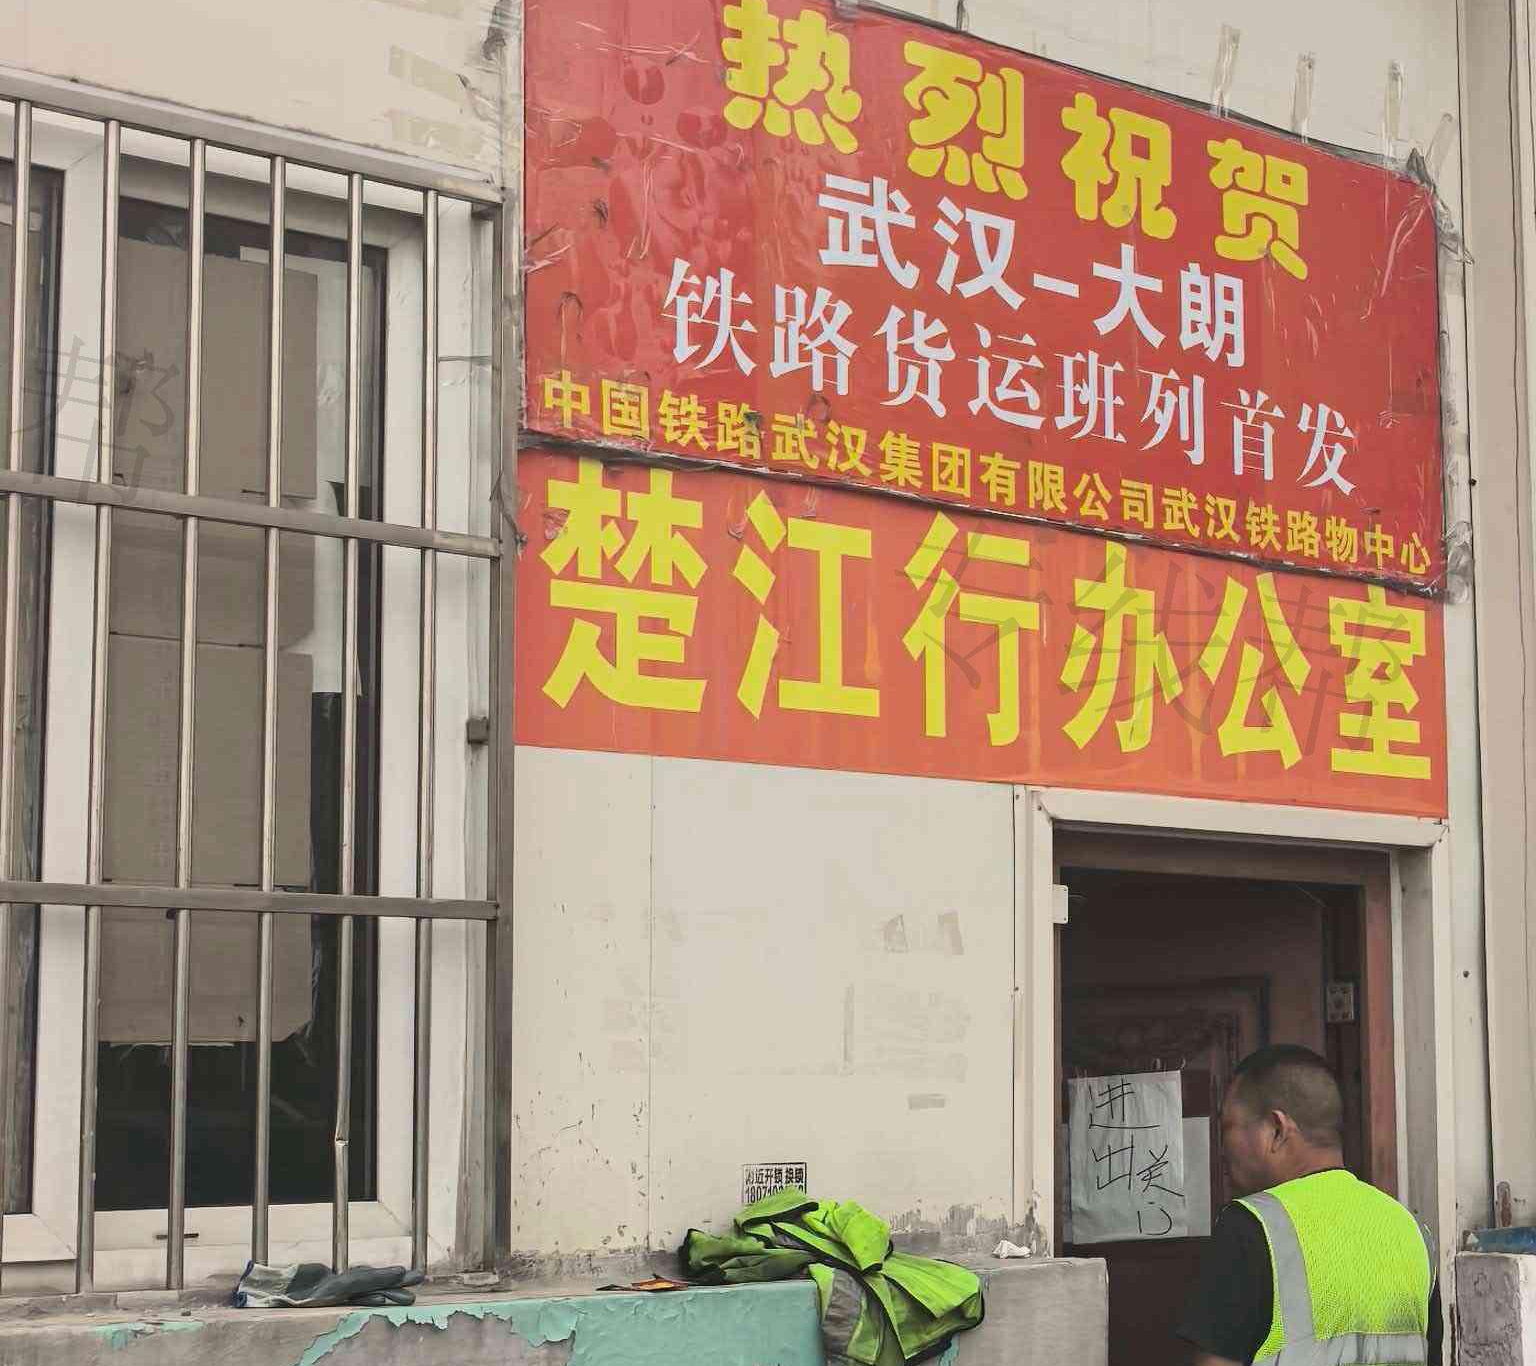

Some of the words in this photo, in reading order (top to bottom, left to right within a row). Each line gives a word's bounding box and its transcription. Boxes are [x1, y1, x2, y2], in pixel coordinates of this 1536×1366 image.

[543, 370, 1432, 576] 中国铁路武汉集团有限公司武汉铁路物中心
[661, 257, 1357, 496] 铁路货运班列首发
[541, 457, 1432, 780] 楚江行办公室
